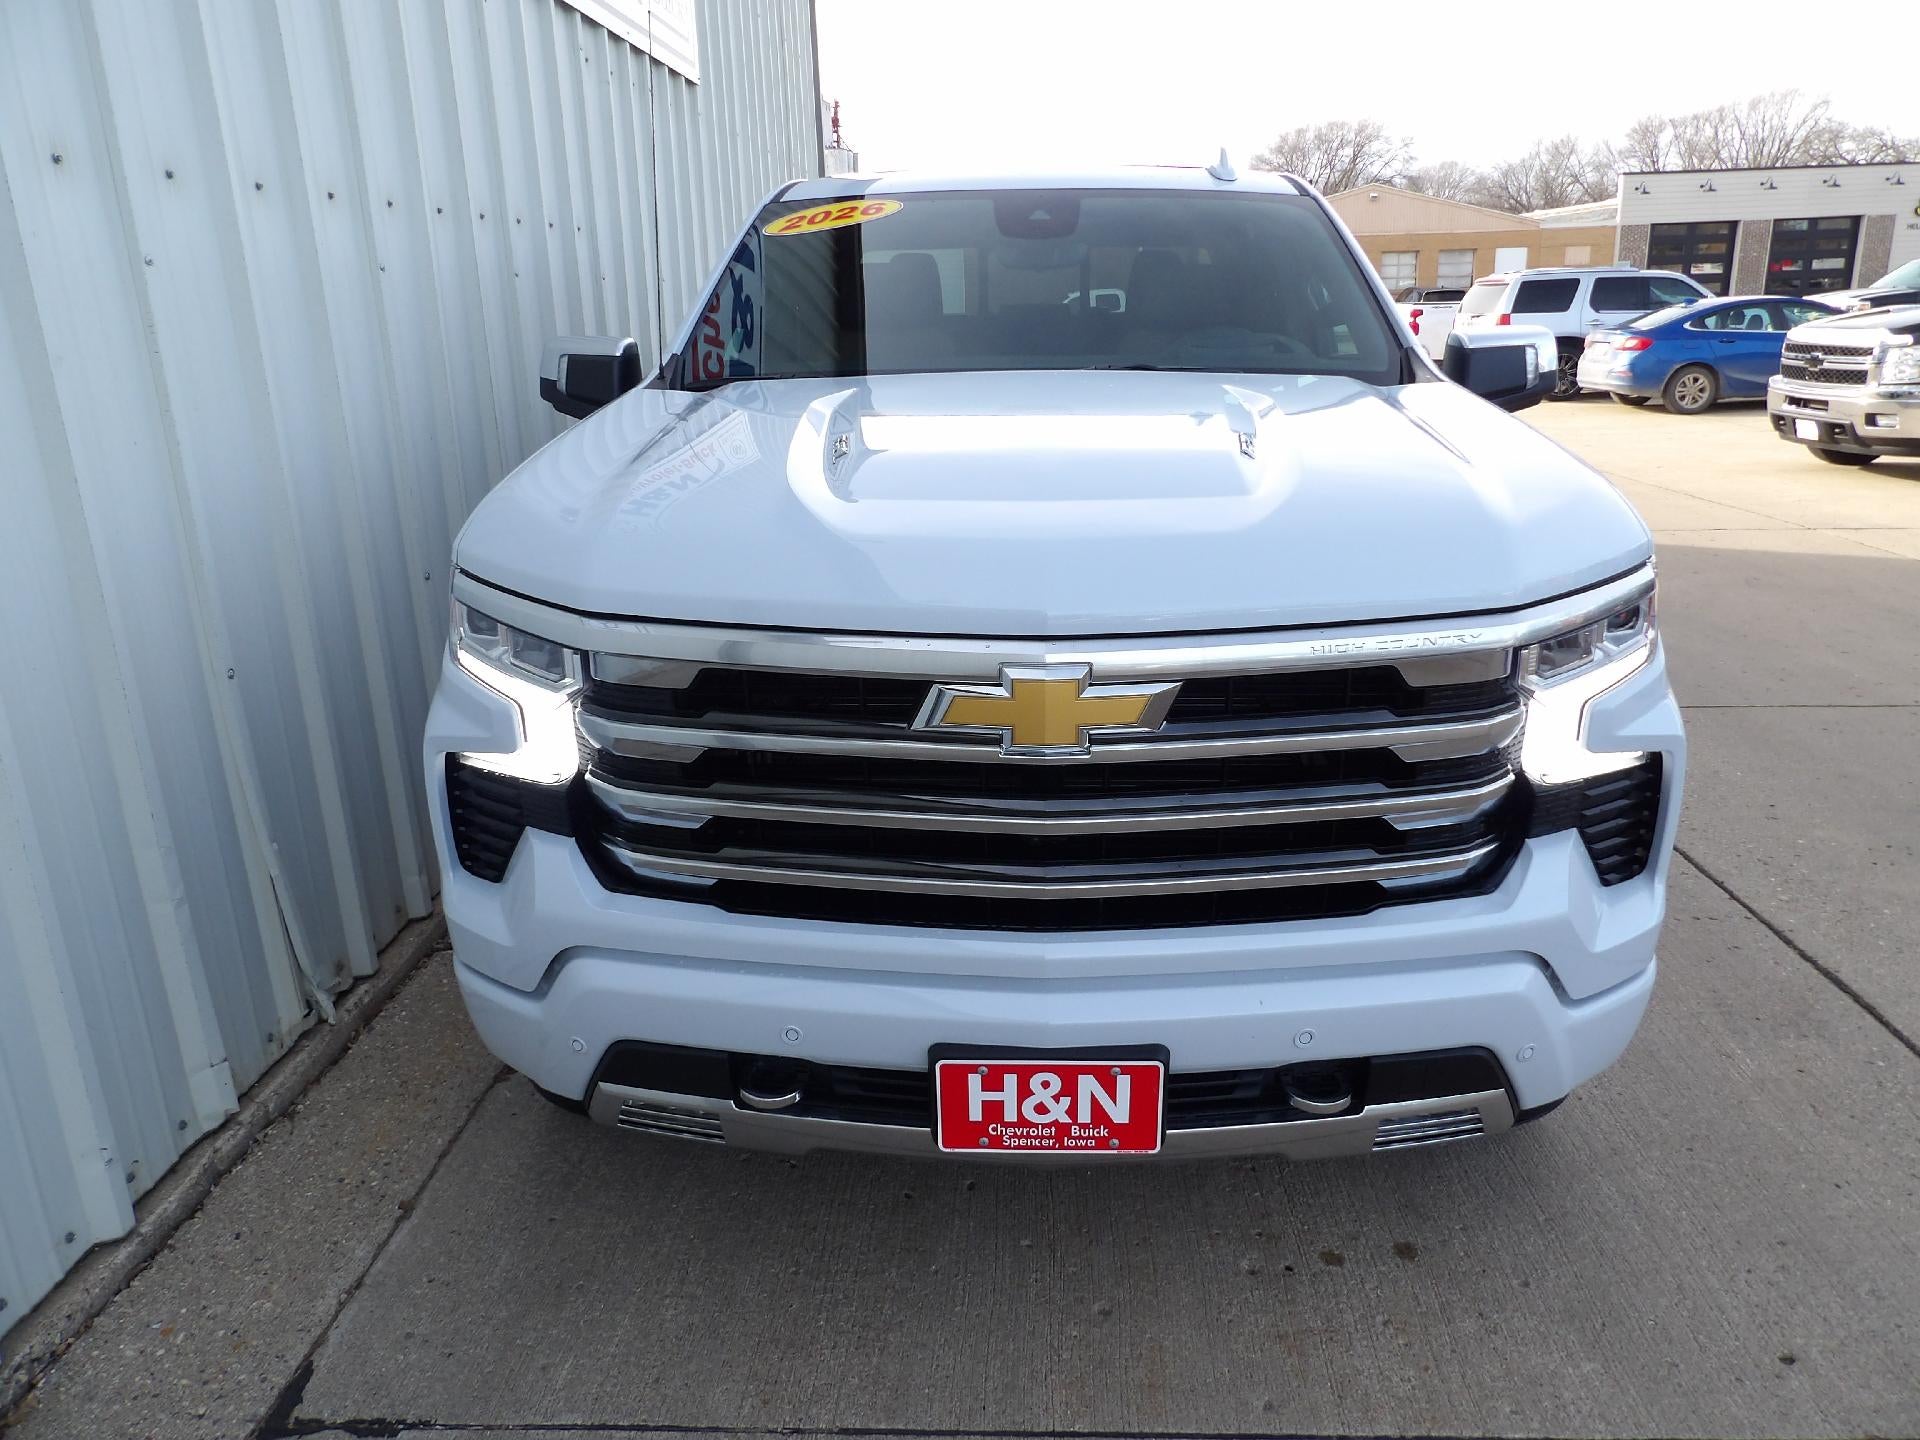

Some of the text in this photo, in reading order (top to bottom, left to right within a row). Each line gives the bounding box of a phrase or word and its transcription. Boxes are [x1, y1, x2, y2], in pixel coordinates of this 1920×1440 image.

[777, 203, 887, 233] 2026
[1310, 633, 1484, 656] HIGH COUNTRY
[968, 1072, 1131, 1124] H&N
[988, 1124, 1109, 1137] Chevrolet Buick
[1002, 1135, 1096, 1148] Spencer, Iowa
